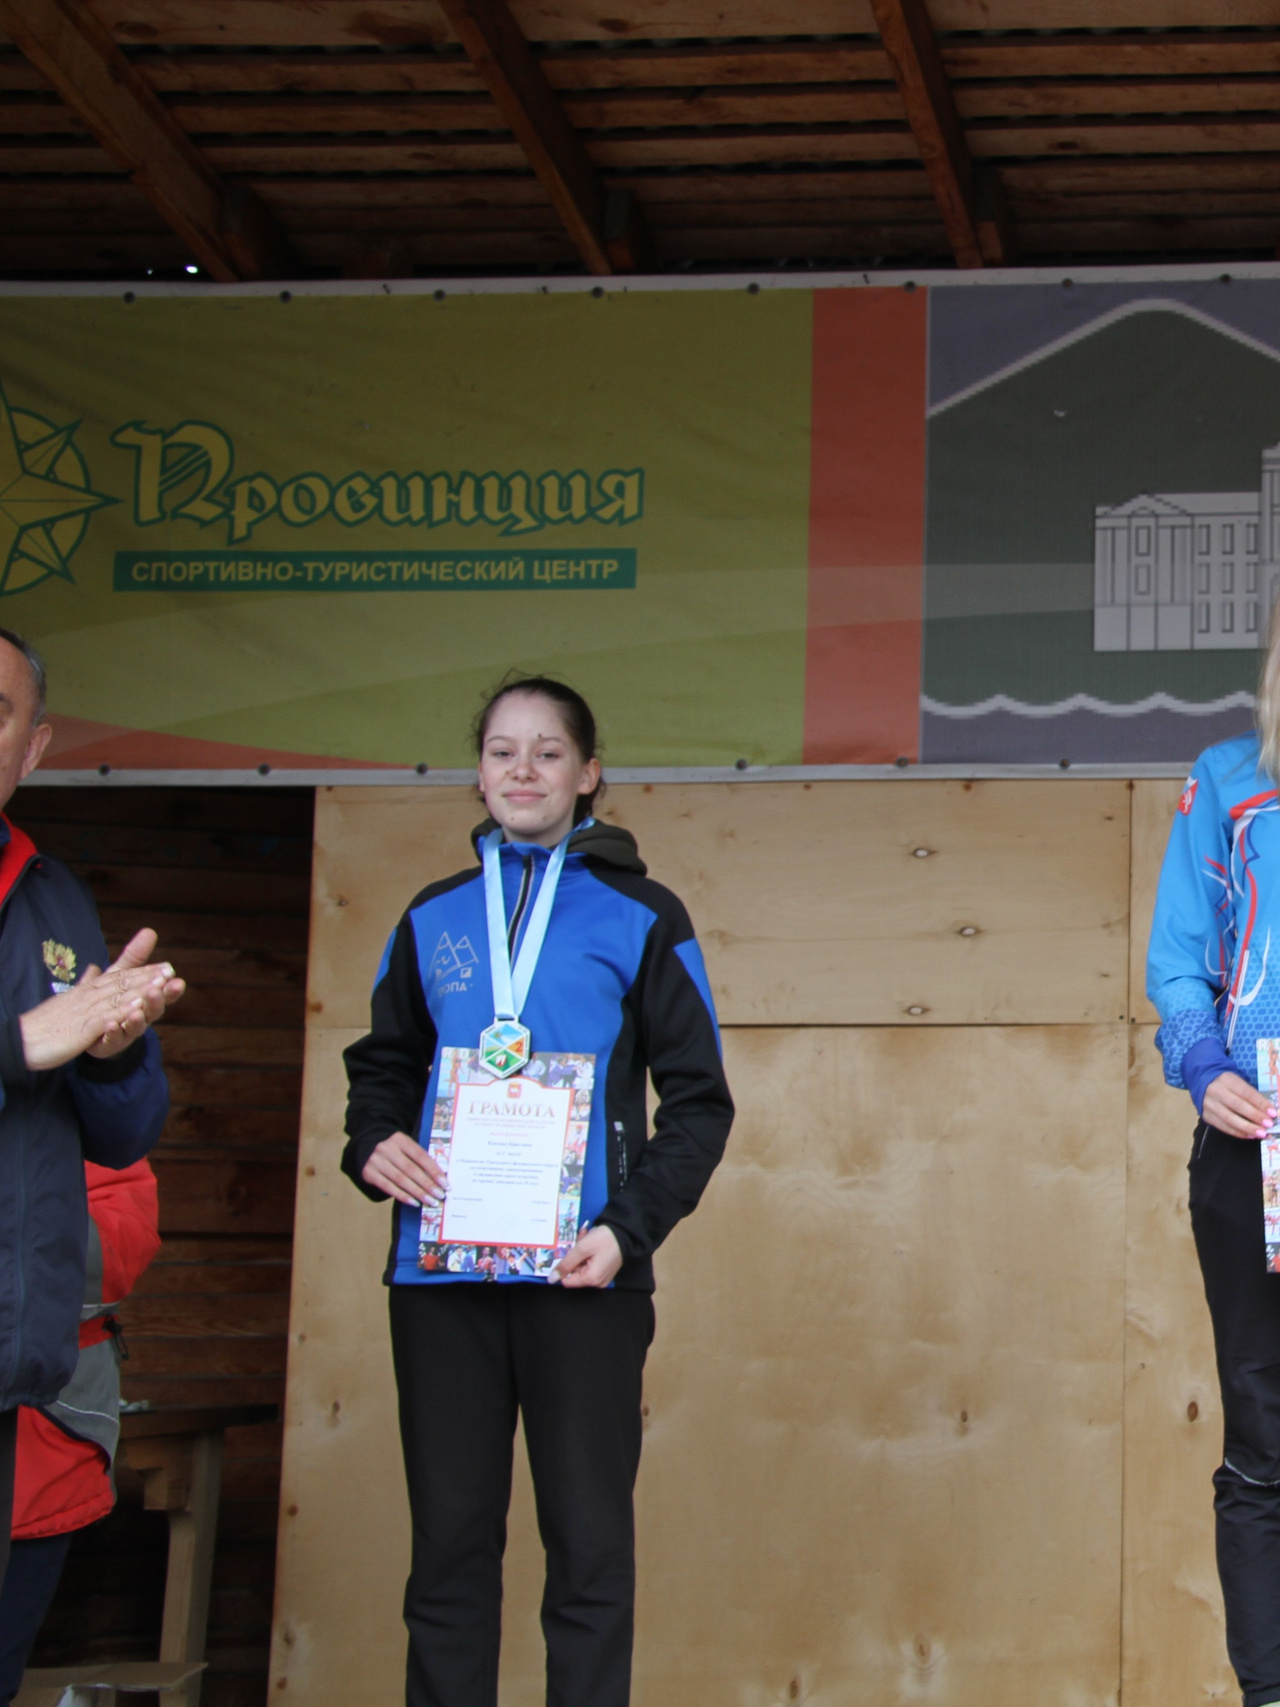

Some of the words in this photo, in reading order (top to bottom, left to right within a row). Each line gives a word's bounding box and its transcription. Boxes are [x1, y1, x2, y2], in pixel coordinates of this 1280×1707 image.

[110, 419, 645, 547] Провинция
[131, 556, 525, 583] СПОРТИВНО-ТУРИСТИЧЕСКИЙ
[532, 558, 619, 585] ЦЕНТР
[468, 1100, 556, 1119] ГРАМОТА
